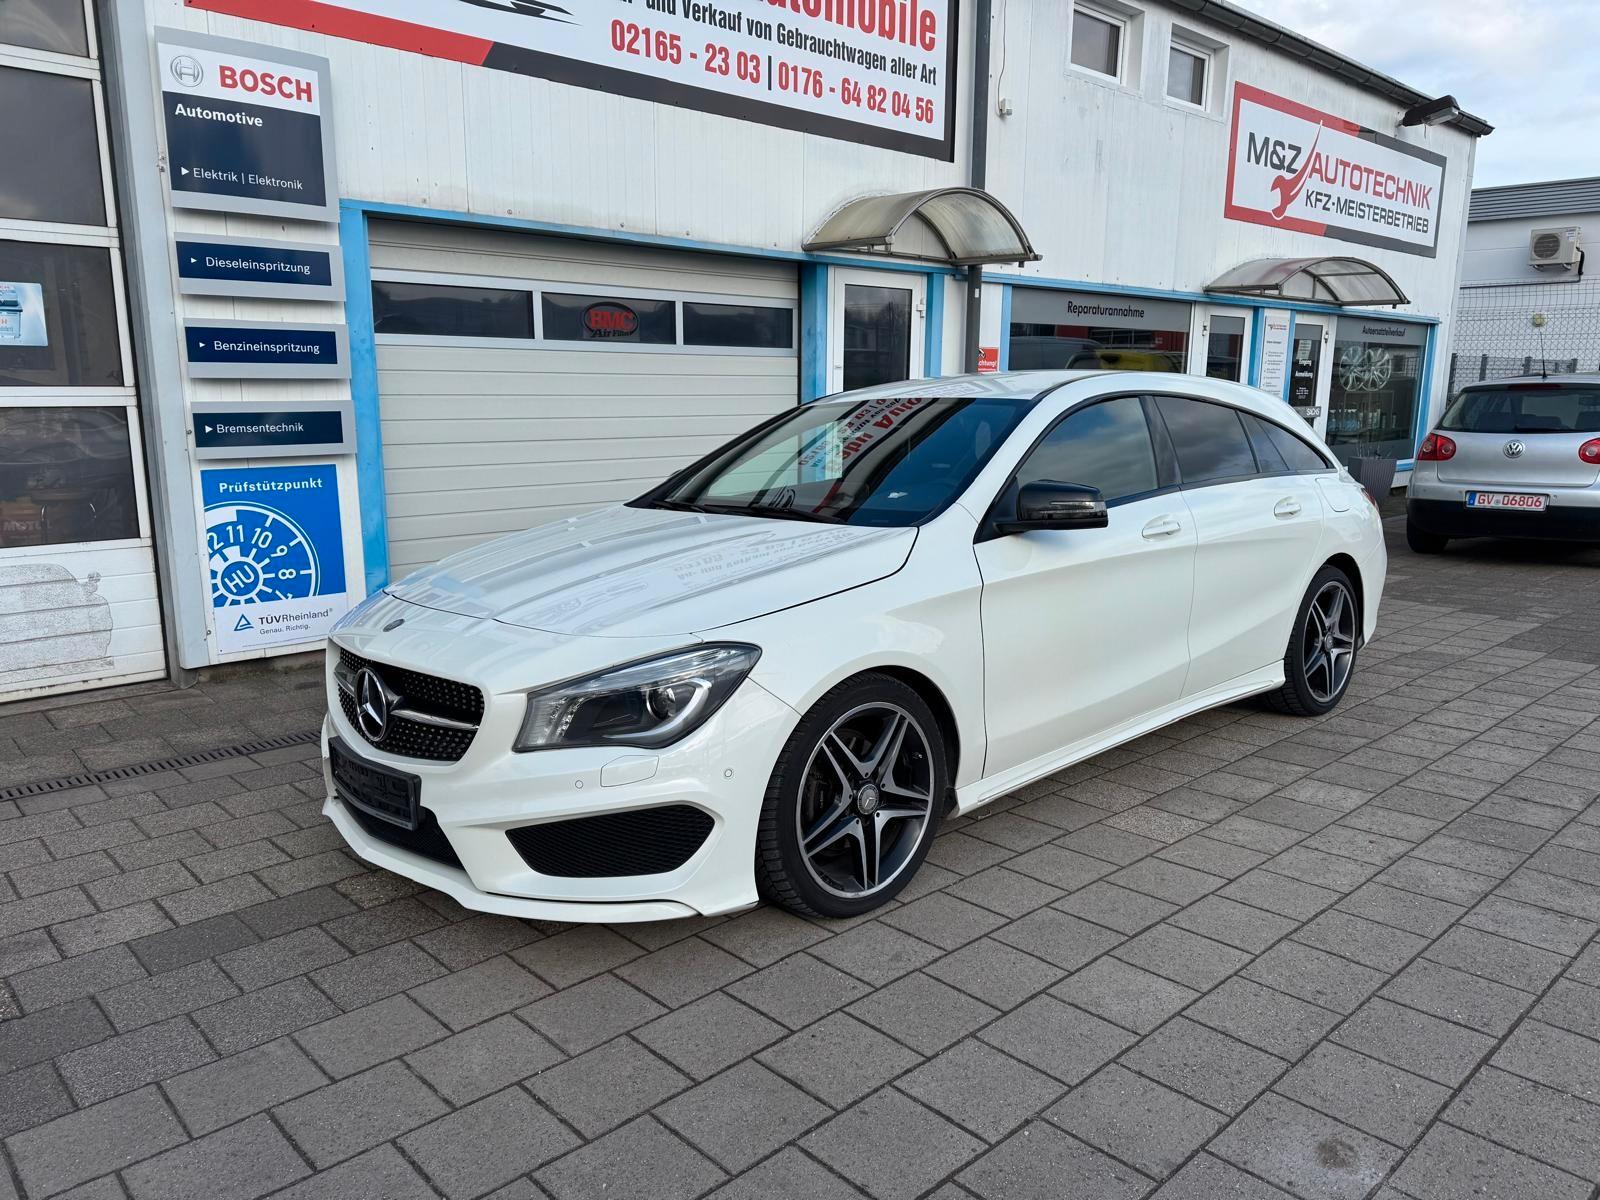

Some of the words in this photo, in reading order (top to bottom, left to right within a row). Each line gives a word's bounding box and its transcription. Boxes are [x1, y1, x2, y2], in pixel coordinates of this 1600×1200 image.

[682, 0, 742, 33] Verkauf
[747, 18, 772, 42] von
[776, 22, 887, 72] Gebrauchtwagen
[890, 57, 918, 80] aller
[920, 63, 937, 86] Art
[611, 19, 682, 65] 02165
[704, 43, 730, 76] 23
[736, 51, 761, 84] 03
[778, 61, 823, 99] 0176
[841, 77, 862, 108] 64
[866, 84, 887, 114] 82
[892, 91, 911, 119] 04
[915, 96, 934, 124] 56
[219, 65, 312, 102] BOSCH
[175, 103, 263, 127] Automotive
[1247, 131, 1302, 174] M&Z
[193, 167, 238, 183] Elektrik
[248, 174, 303, 190] Elektronik
[1308, 152, 1433, 210] AUTOTECHNIK
[205, 256, 311, 275] Dieseleinspritzung
[1067, 301, 1145, 318] Reparaturannahme
[214, 340, 320, 354] Benzineinspritzung
[978, 359, 998, 368] chtung!
[216, 423, 304, 434] Bremsentechnik
[219, 478, 323, 493] Prüfstützpunkt
[1477, 494, 1495, 505] GV
[1501, 495, 1542, 508] 06806
[226, 525, 244, 543] 11
[251, 527, 272, 548] 10
[224, 565, 255, 593] HU
[278, 568, 296, 580] 8
[286, 624, 311, 632] Richtig.
